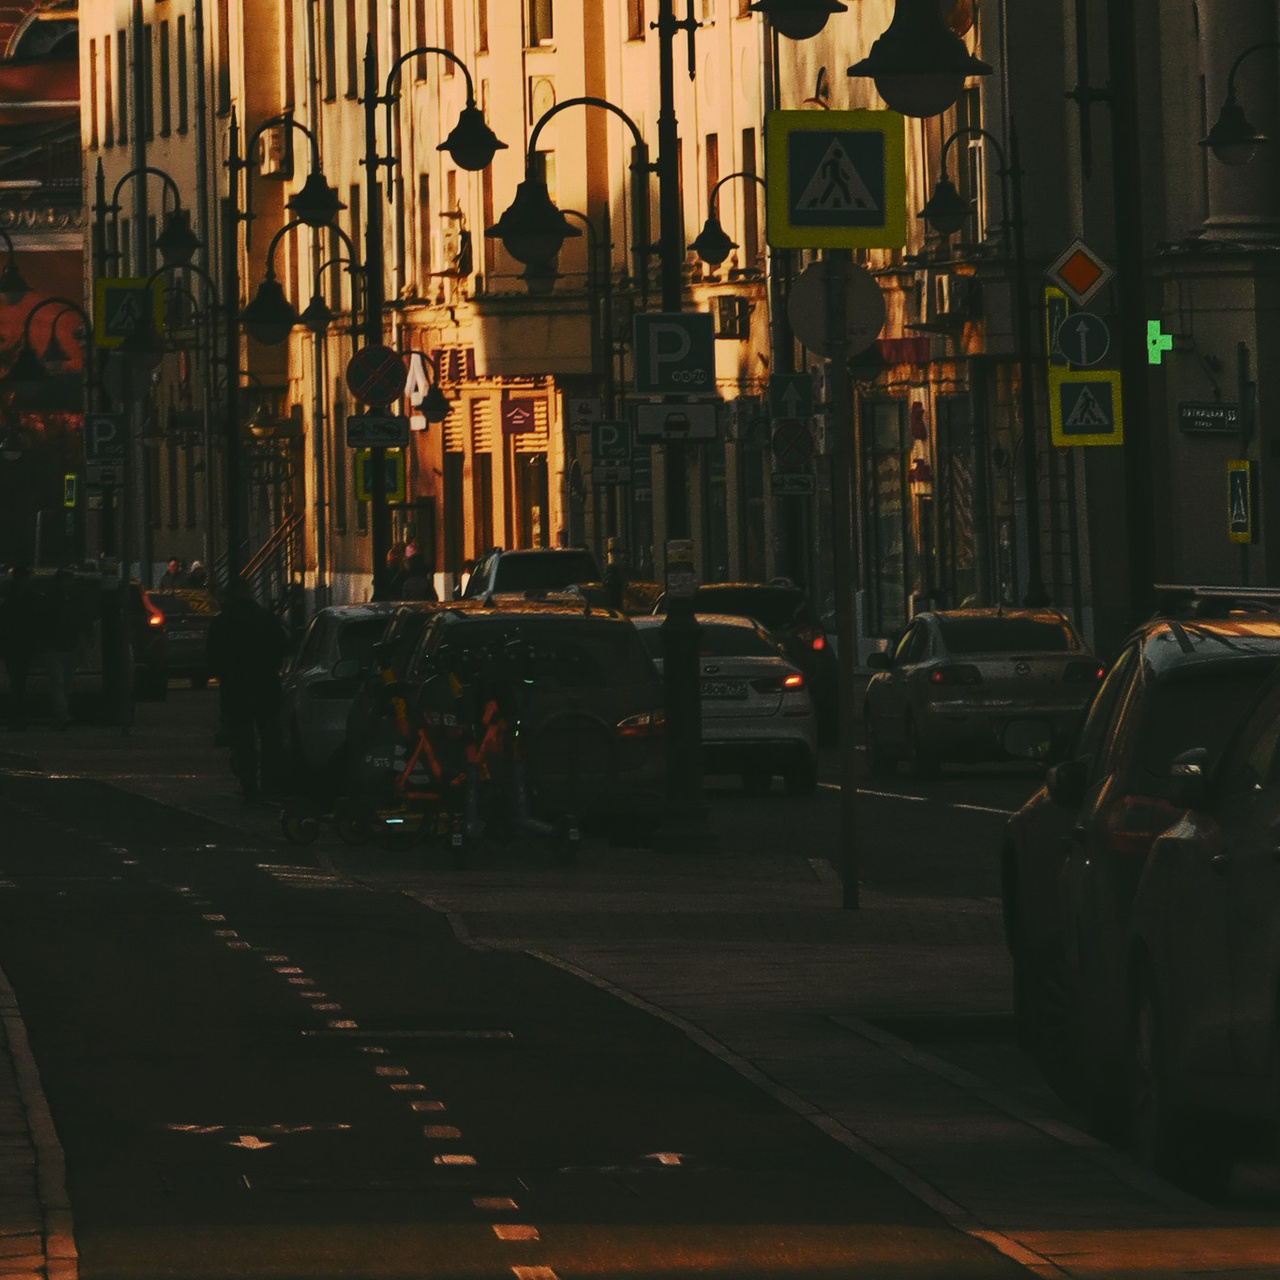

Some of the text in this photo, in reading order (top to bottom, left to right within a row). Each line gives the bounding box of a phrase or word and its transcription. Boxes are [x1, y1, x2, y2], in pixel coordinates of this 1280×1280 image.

[649, 323, 691, 385] P
[93, 419, 116, 455] P
[599, 426, 619, 455] P
